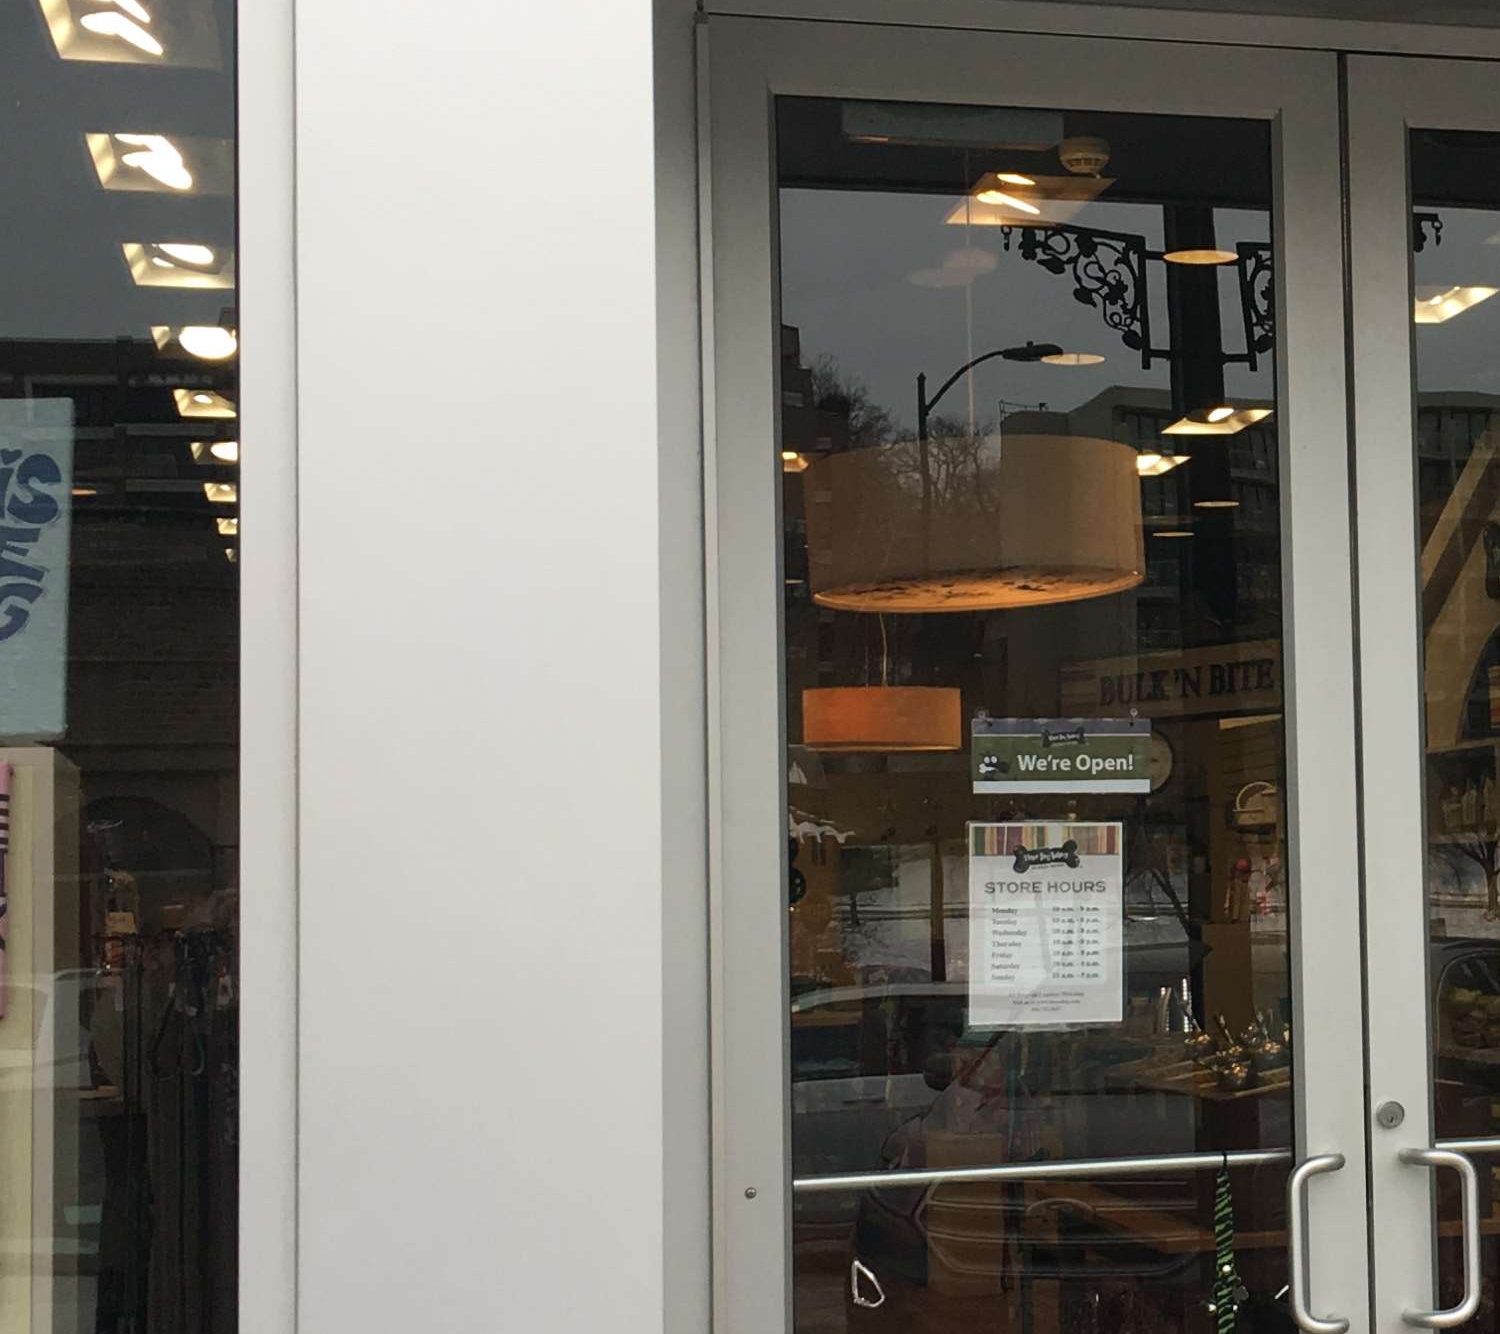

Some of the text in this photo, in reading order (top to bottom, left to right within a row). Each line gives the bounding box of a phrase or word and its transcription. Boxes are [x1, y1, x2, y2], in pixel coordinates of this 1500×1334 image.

[1099, 670, 1171, 706] BULK
[1016, 753, 1135, 775] We're Open!
[984, 880, 1106, 894] STORE HOURS
